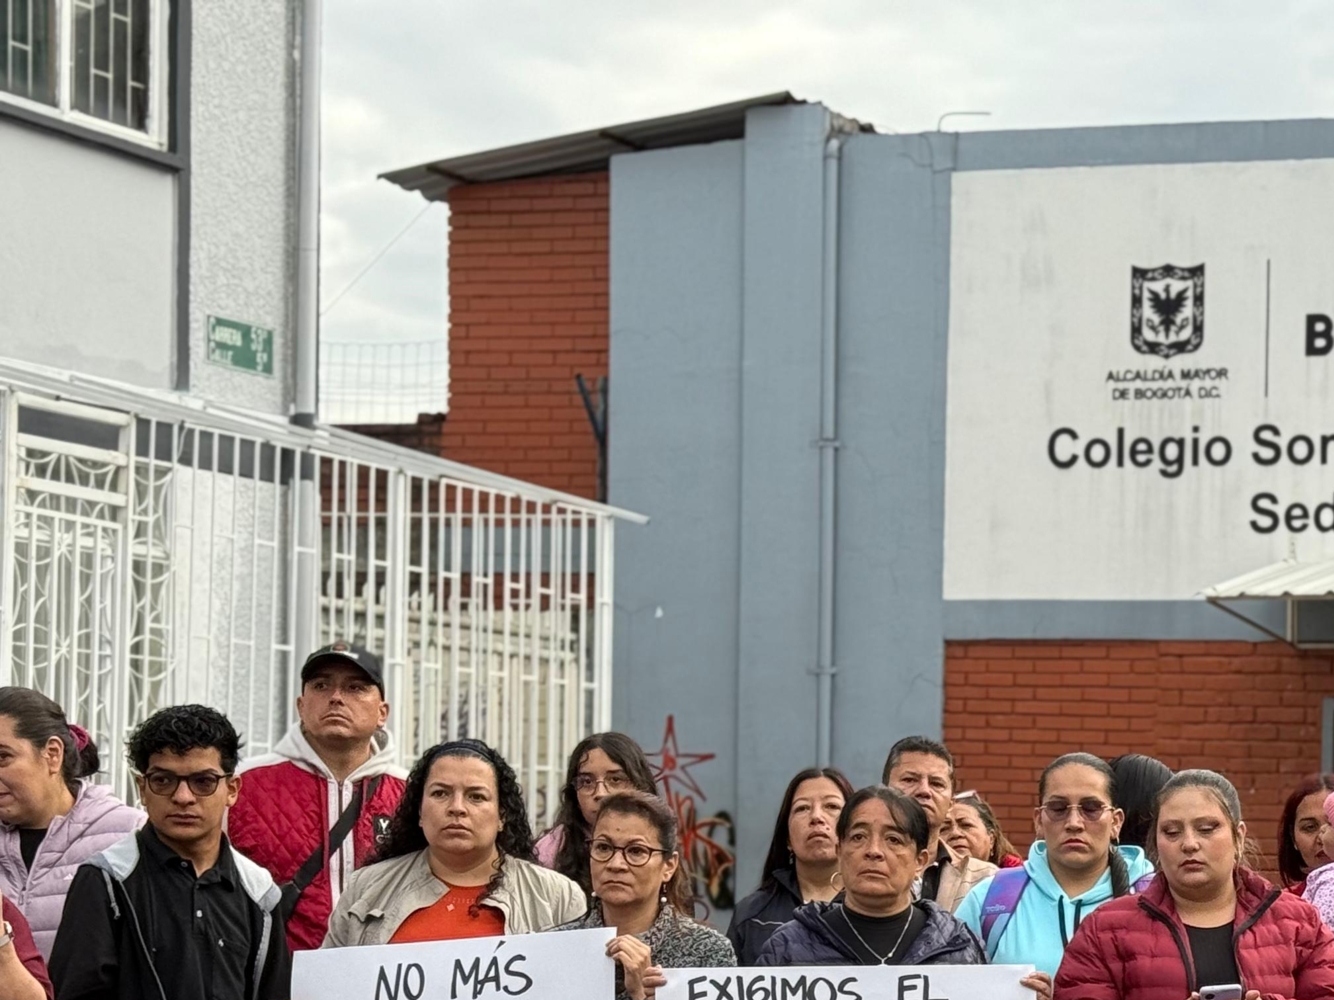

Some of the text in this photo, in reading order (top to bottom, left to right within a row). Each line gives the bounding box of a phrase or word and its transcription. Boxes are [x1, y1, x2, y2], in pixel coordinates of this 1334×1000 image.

[1105, 366, 1229, 382] ALCALDÍA MAYOR
[1112, 388, 1130, 400] DE
[1134, 384, 1193, 400] BOGOTÁ
[1047, 425, 1232, 479] Colegio
[450, 940, 533, 999] MÁS
